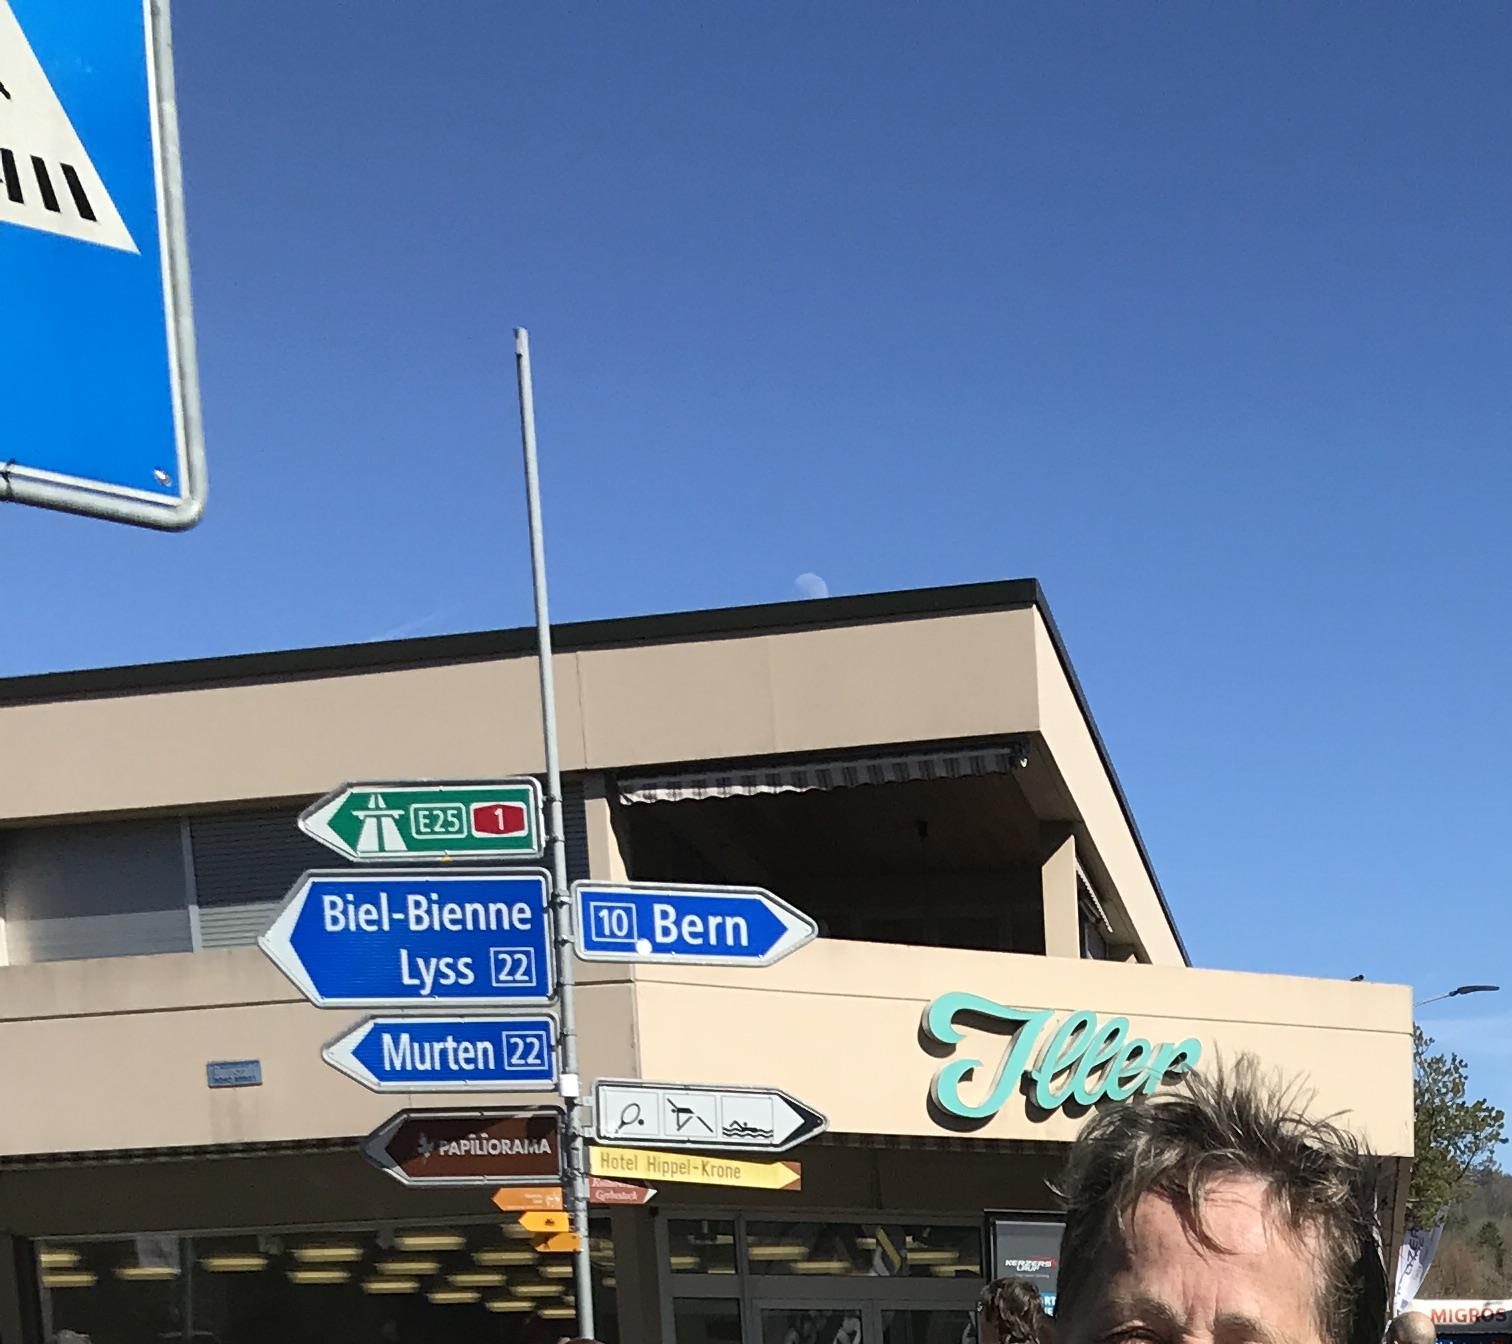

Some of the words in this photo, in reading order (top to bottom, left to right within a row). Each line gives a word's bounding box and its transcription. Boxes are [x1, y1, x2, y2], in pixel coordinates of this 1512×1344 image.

[419, 809, 460, 834] E25
[494, 808, 504, 831] 1
[323, 893, 532, 933] Biel-Bienne
[598, 908, 629, 937] 10
[654, 904, 749, 947] Bern
[401, 949, 475, 995] Lyss
[498, 953, 528, 983] 22
[382, 1032, 495, 1072] Murten
[509, 1037, 542, 1065] 22
[439, 1132, 552, 1156] PAPILIORAMA
[600, 1152, 638, 1172] Hotel
[647, 1155, 742, 1179] Hippel-Krone
[1431, 1307, 1507, 1323] MIGROS
